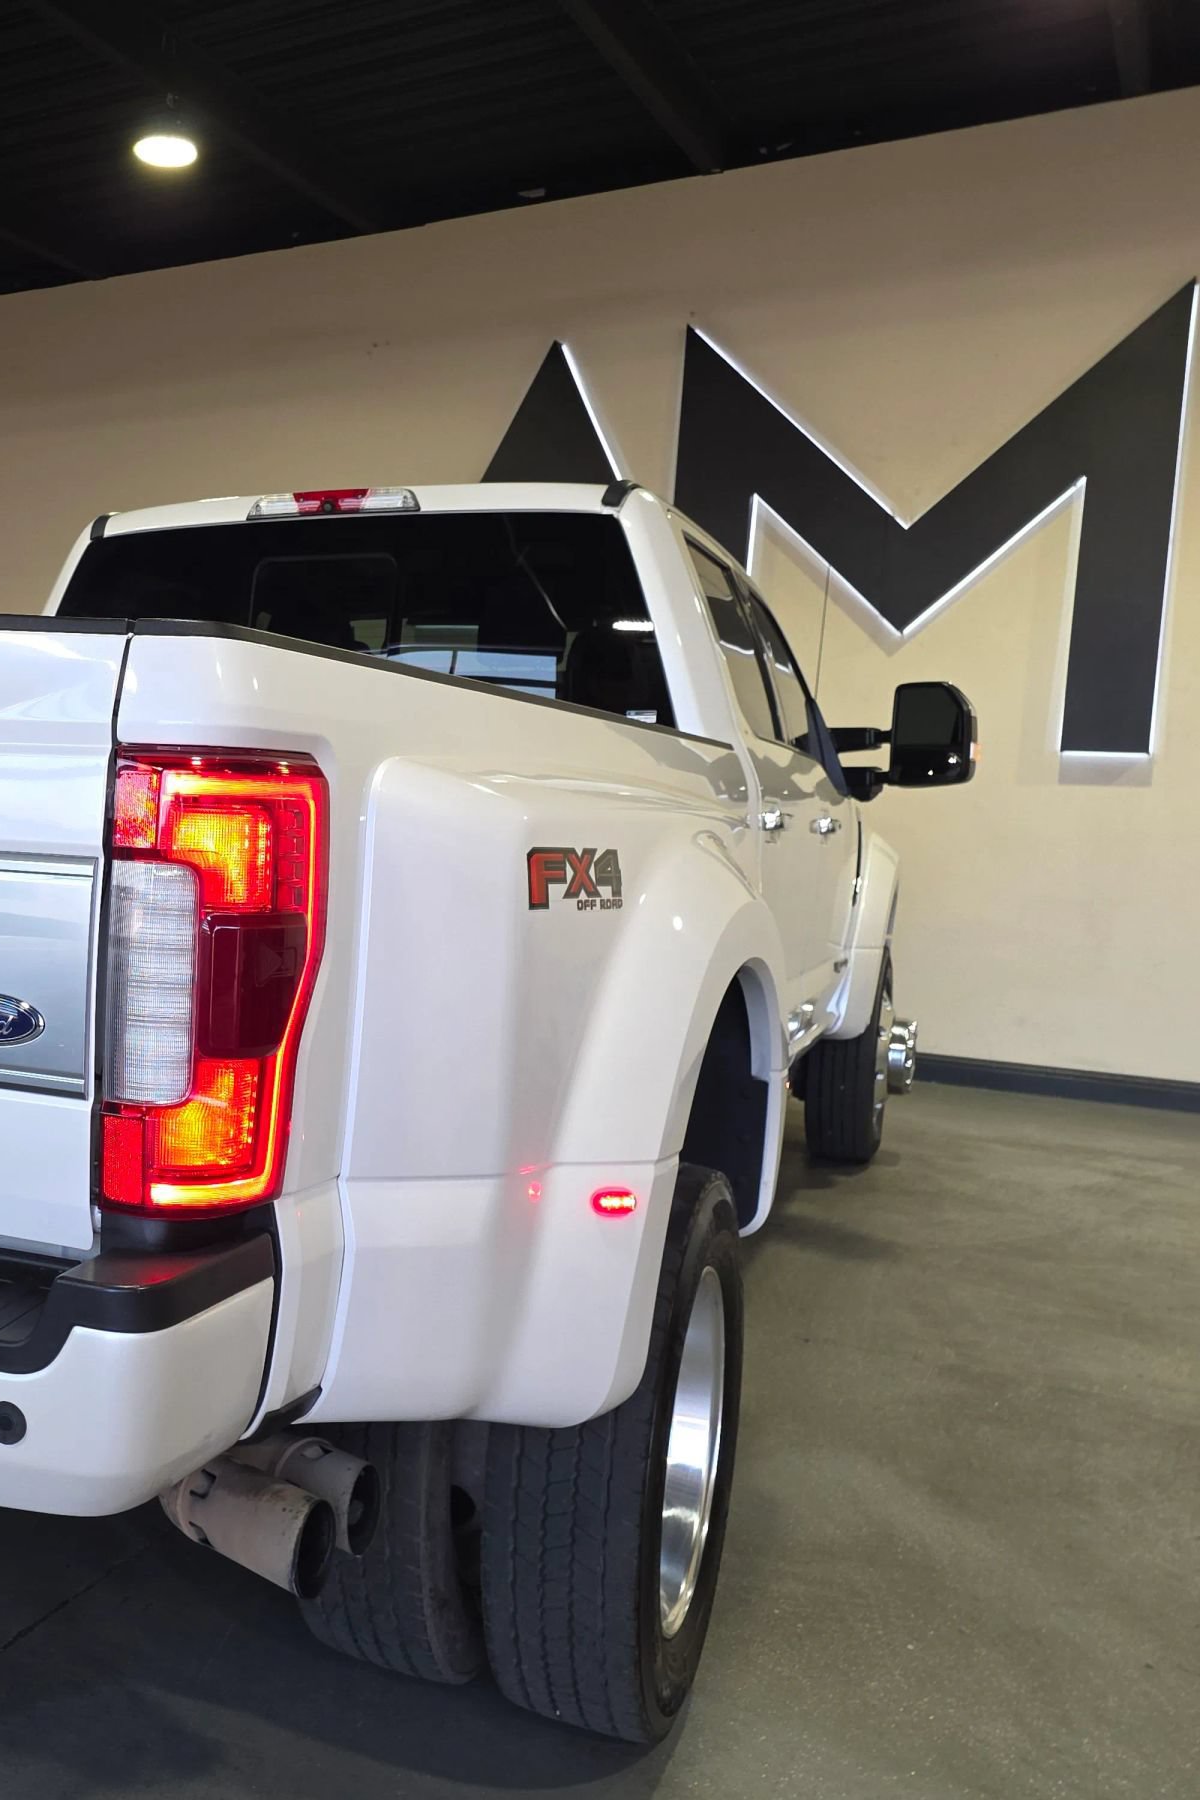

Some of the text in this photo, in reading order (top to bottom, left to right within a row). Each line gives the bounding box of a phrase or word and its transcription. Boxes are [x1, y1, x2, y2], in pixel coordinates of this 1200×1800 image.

[527, 847, 622, 910] FX4
[577, 898, 623, 911] OFF ROAD
